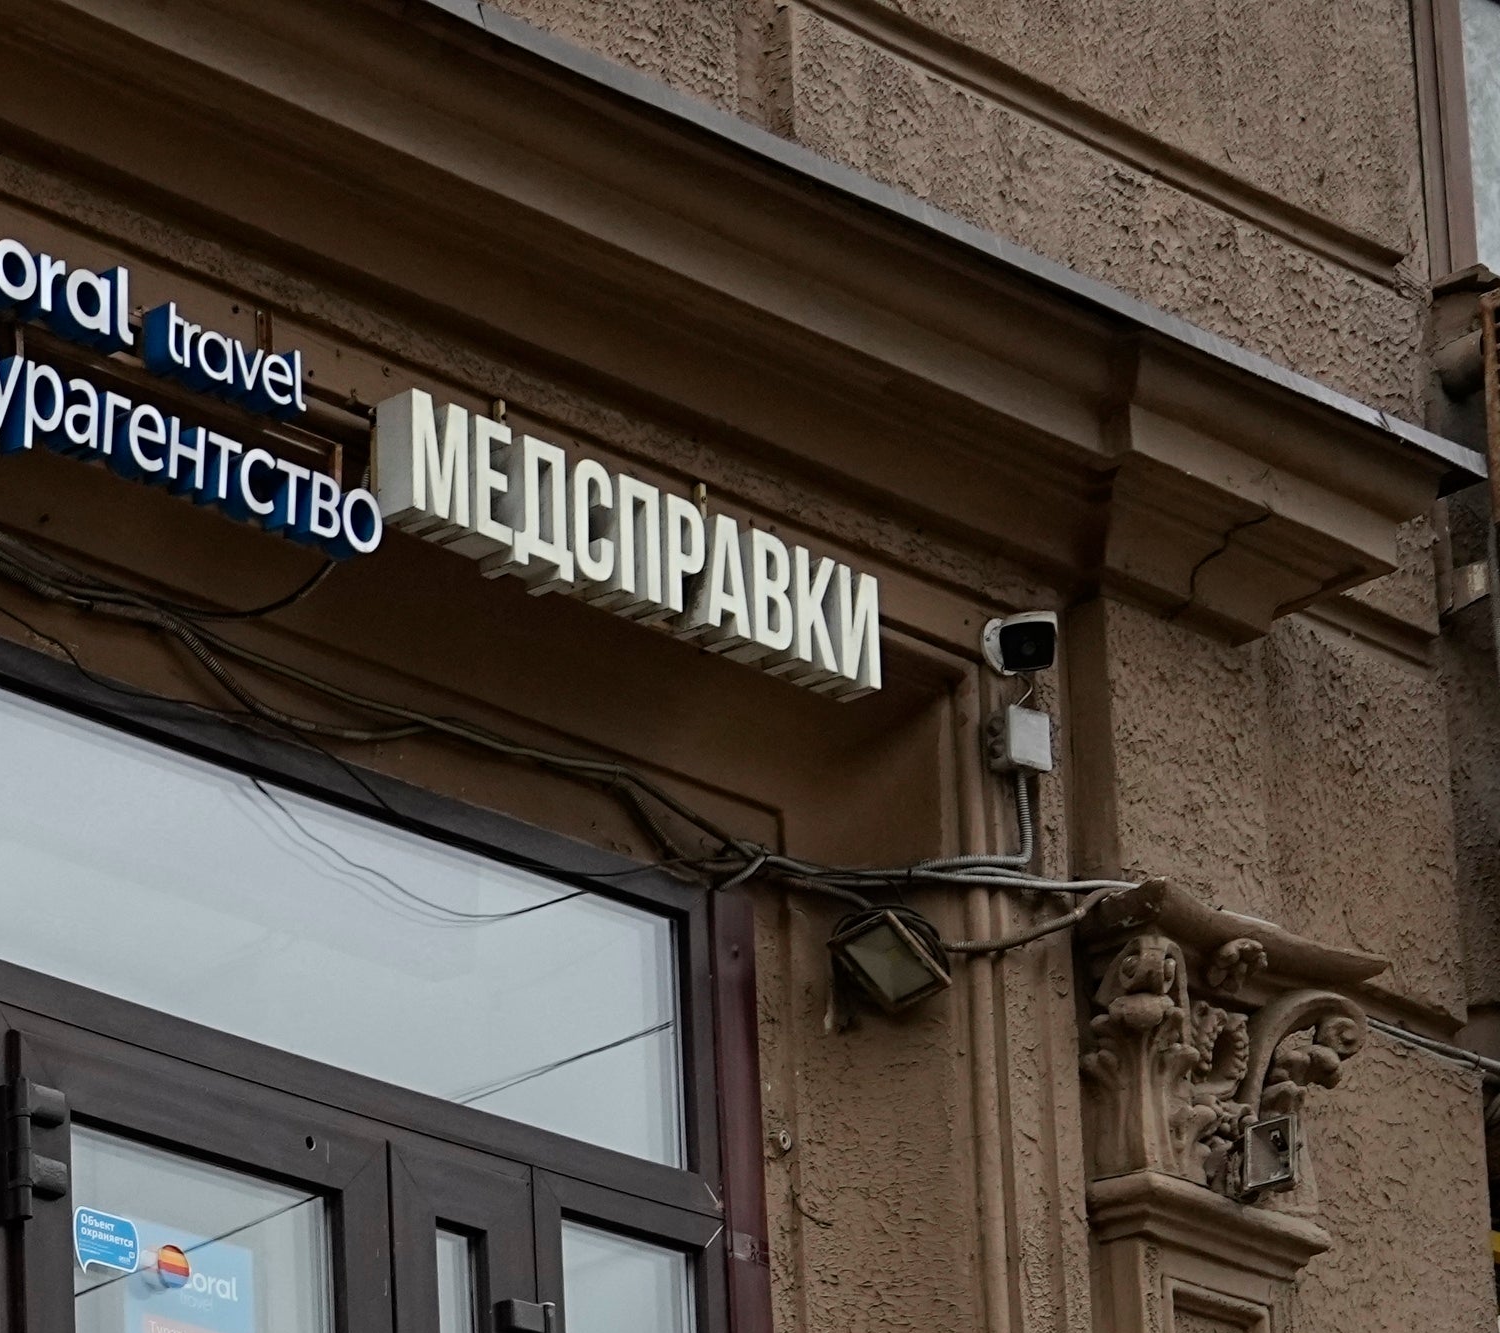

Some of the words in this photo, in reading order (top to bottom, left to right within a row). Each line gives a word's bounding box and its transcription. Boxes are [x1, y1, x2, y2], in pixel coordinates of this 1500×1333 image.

[169, 301, 307, 412] travel
[411, 388, 882, 690] МЕДСПРАВКИ
[80, 1213, 115, 1232] Объект
[80, 1226, 134, 1249] охраняется
[184, 1273, 238, 1301] oral
